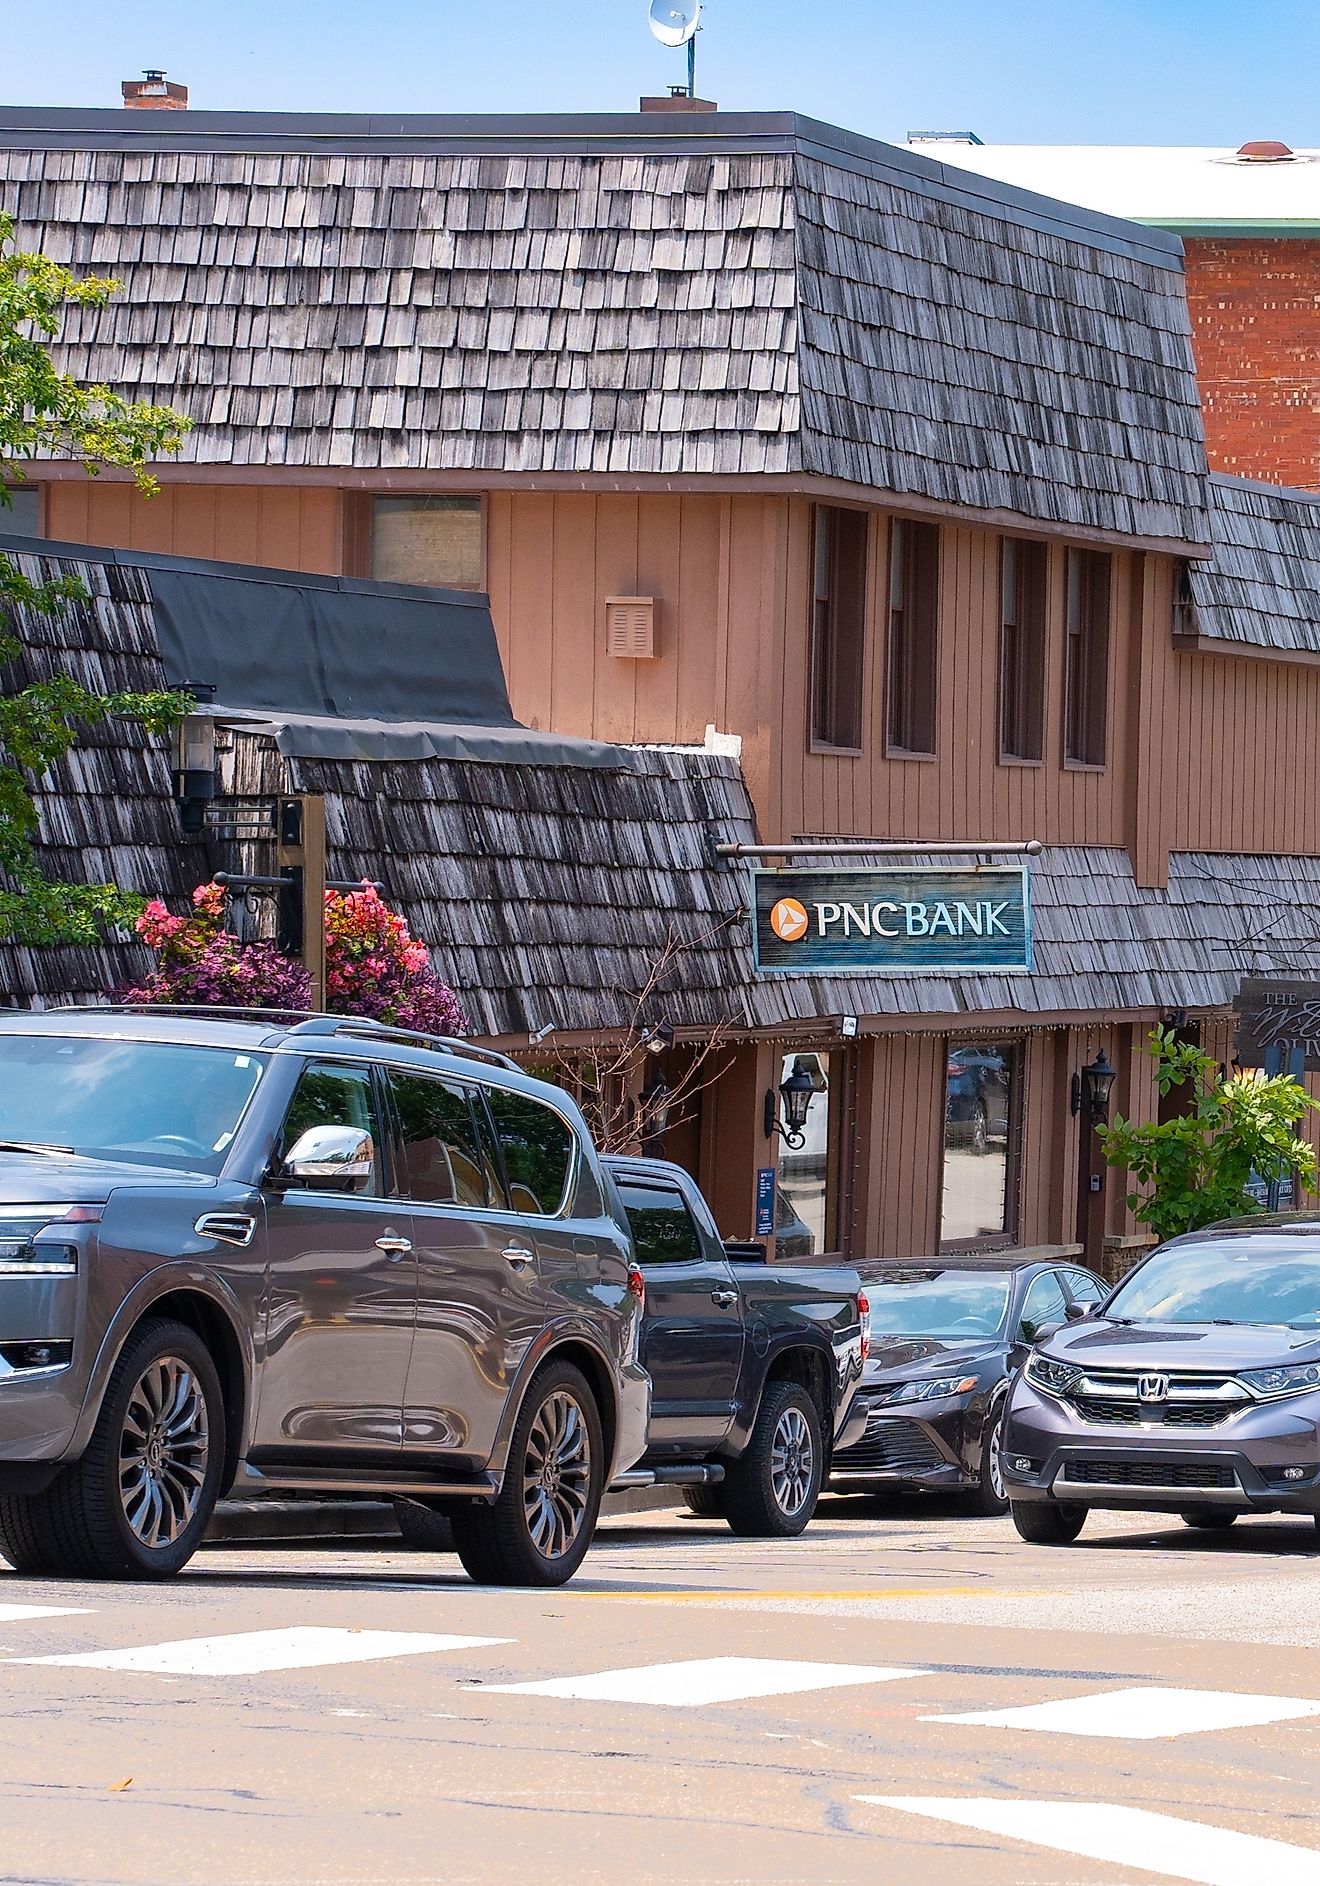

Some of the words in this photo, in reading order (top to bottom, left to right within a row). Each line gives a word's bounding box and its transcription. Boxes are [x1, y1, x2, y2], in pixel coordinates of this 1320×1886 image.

[813, 902, 899, 937] PNC
[902, 902, 1011, 936] BANK
[1263, 992, 1297, 1006] THE
